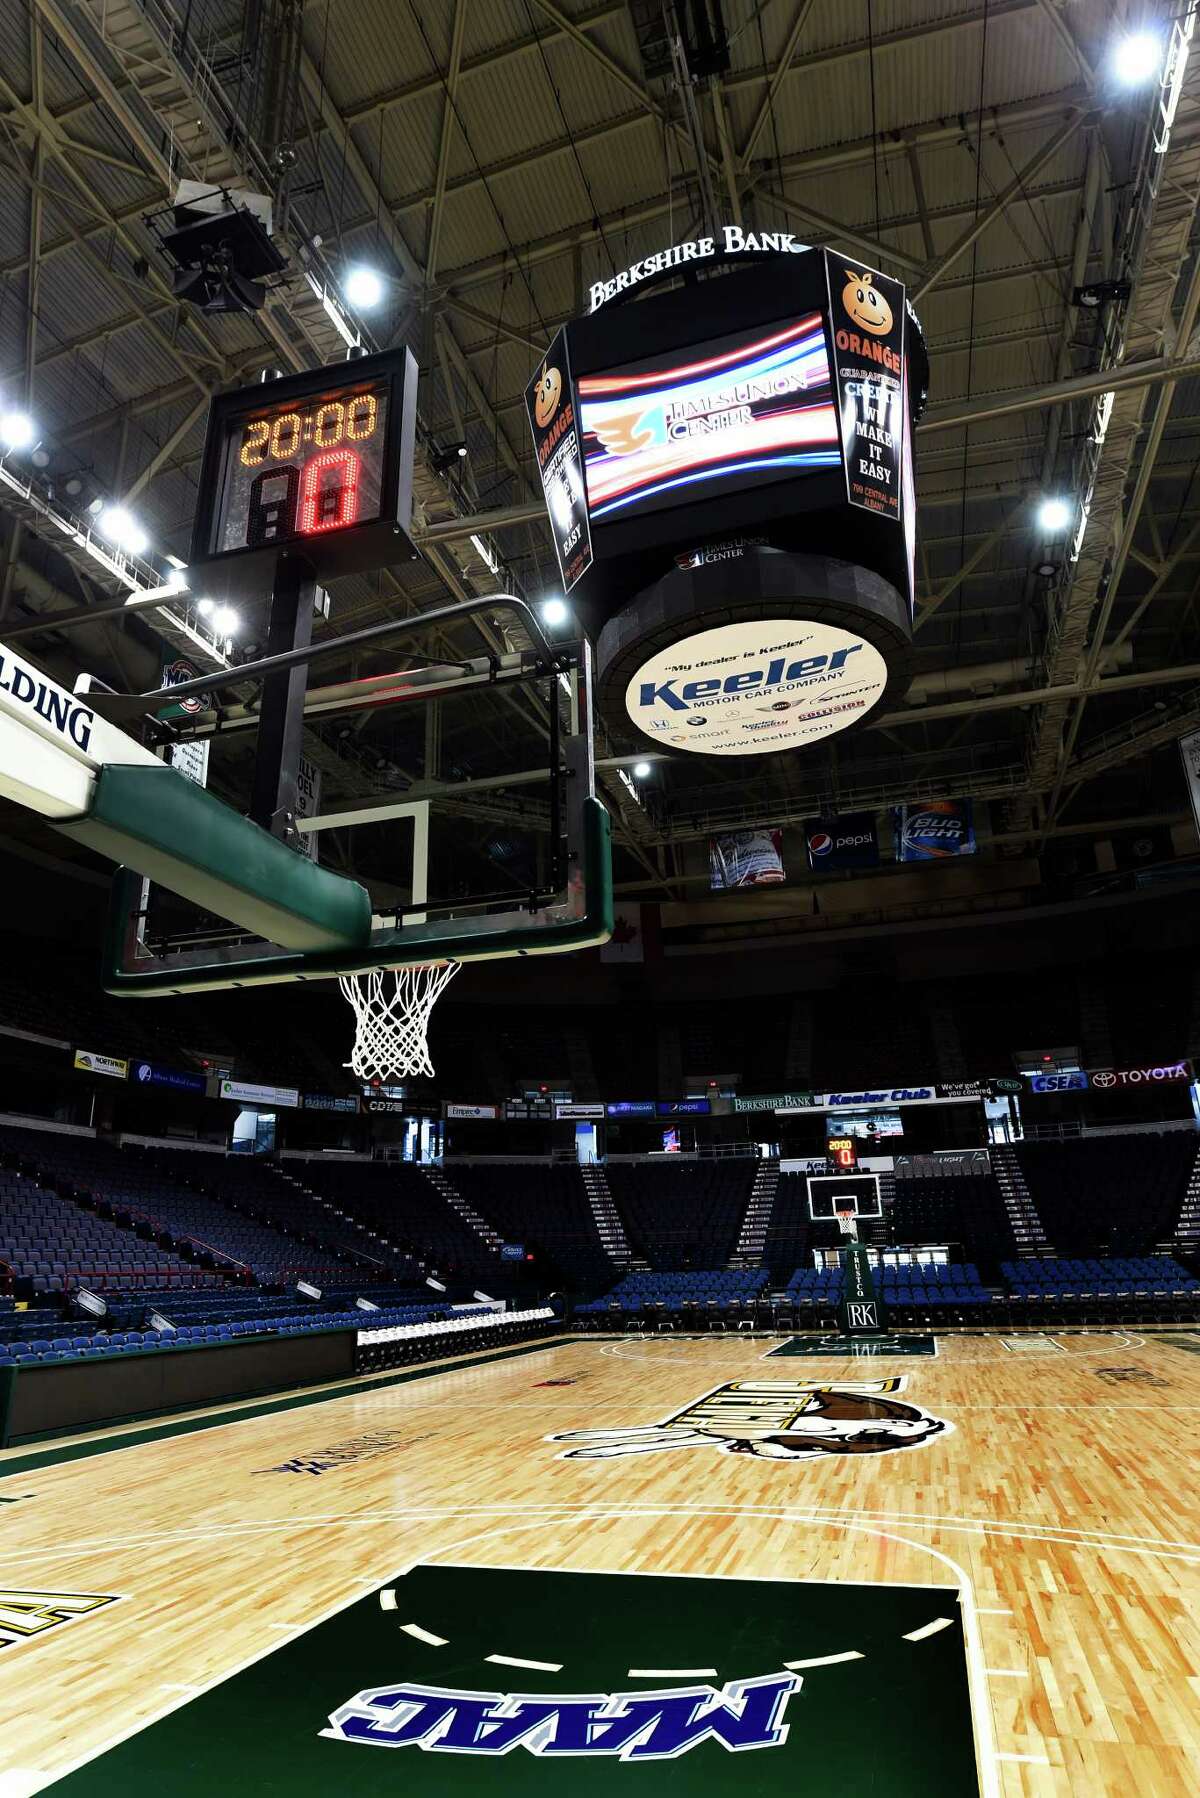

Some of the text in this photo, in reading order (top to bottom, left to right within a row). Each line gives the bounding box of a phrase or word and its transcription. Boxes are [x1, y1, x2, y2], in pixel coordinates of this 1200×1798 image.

[589, 226, 797, 314] BERKSHIRE BANK
[836, 330, 901, 374] ORANGE
[240, 394, 377, 467] 20:00
[540, 402, 574, 465] ORANGE
[856, 421, 893, 448] MAKE
[868, 443, 883, 461] IT
[859, 458, 892, 484] EASY
[864, 487, 888, 503] CENTRAL
[864, 495, 885, 512] ALBANY
[563, 523, 582, 557] EASY
[705, 548, 744, 563] CENTER
[695, 654, 739, 668] dealer
[743, 650, 756, 659] is
[640, 644, 863, 711] Keeler
[693, 671, 847, 709] MOTOR CAR COMPANY
[712, 724, 833, 750] www.keeler.com
[913, 817, 963, 829] BUD
[836, 832, 873, 849] pepsi
[906, 828, 965, 839] LIGHT
[1118, 1062, 1188, 1084] TOYOTA
[941, 1081, 978, 1091] We've got
[1034, 1075, 1084, 1092] CSEA
[735, 1094, 812, 1111] BERKSHIRE BANK
[828, 1089, 931, 1106] Keeler Club
[948, 1089, 962, 1098] you
[678, 1103, 699, 1112] pepsi
[828, 1140, 852, 1151] 20:00
[853, 1250, 864, 1297] TRUSTCO
[849, 1304, 876, 1326] RK
[317, 1672, 804, 1762] MAAC
